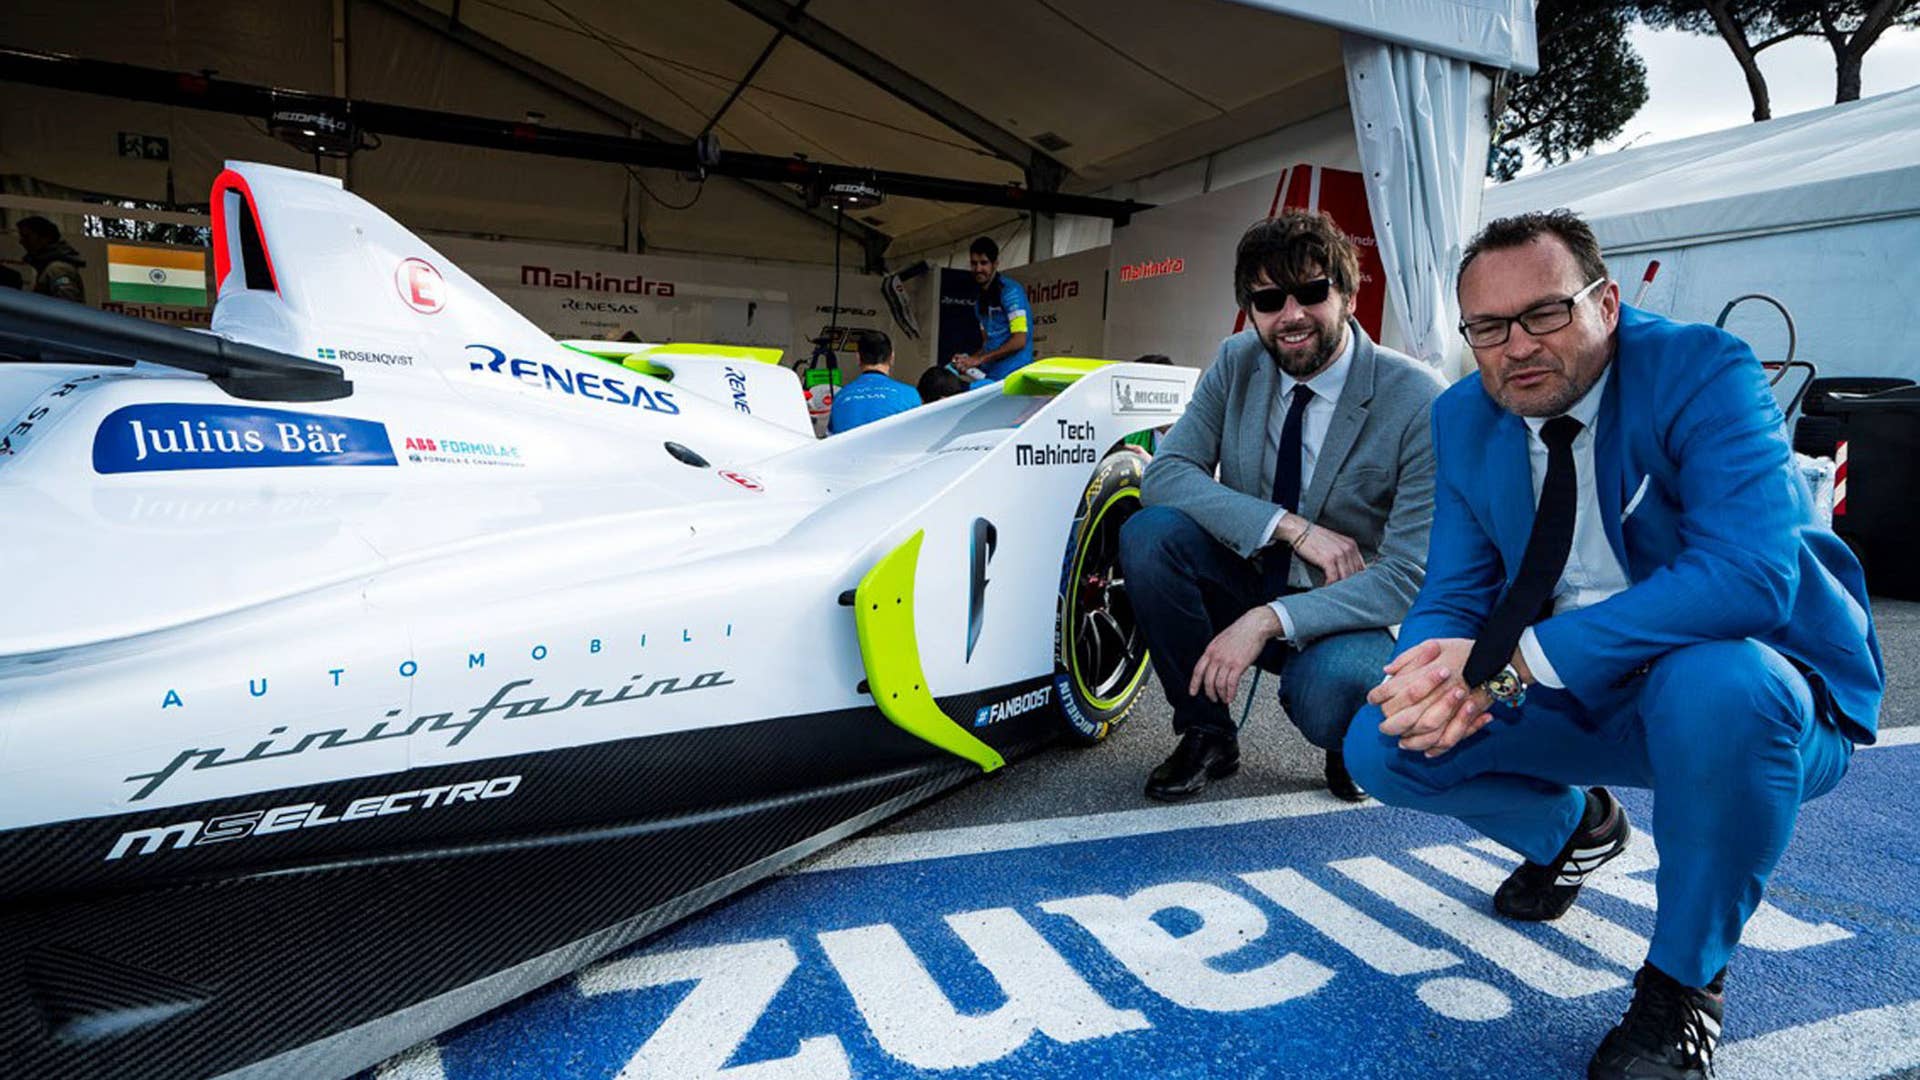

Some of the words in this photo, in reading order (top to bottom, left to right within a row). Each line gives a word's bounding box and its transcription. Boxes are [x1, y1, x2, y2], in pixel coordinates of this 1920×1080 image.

[521, 265, 675, 297] Mahindra
[1120, 257, 1184, 281] Mahindra
[1027, 279, 1079, 304] hindra
[562, 299, 639, 314] RENESAS
[339, 350, 414, 366] ROSENQVIST
[465, 344, 680, 416] RENESAS
[725, 367, 751, 415] RENE
[1134, 391, 1180, 404] MICHELIN
[129, 420, 263, 460] Julius
[276, 423, 348, 455] Bär
[1057, 420, 1095, 441] Tech
[405, 437, 437, 452] ABB
[1016, 444, 1096, 466] Mahindra
[1060, 681, 1096, 735] MICHELIN
